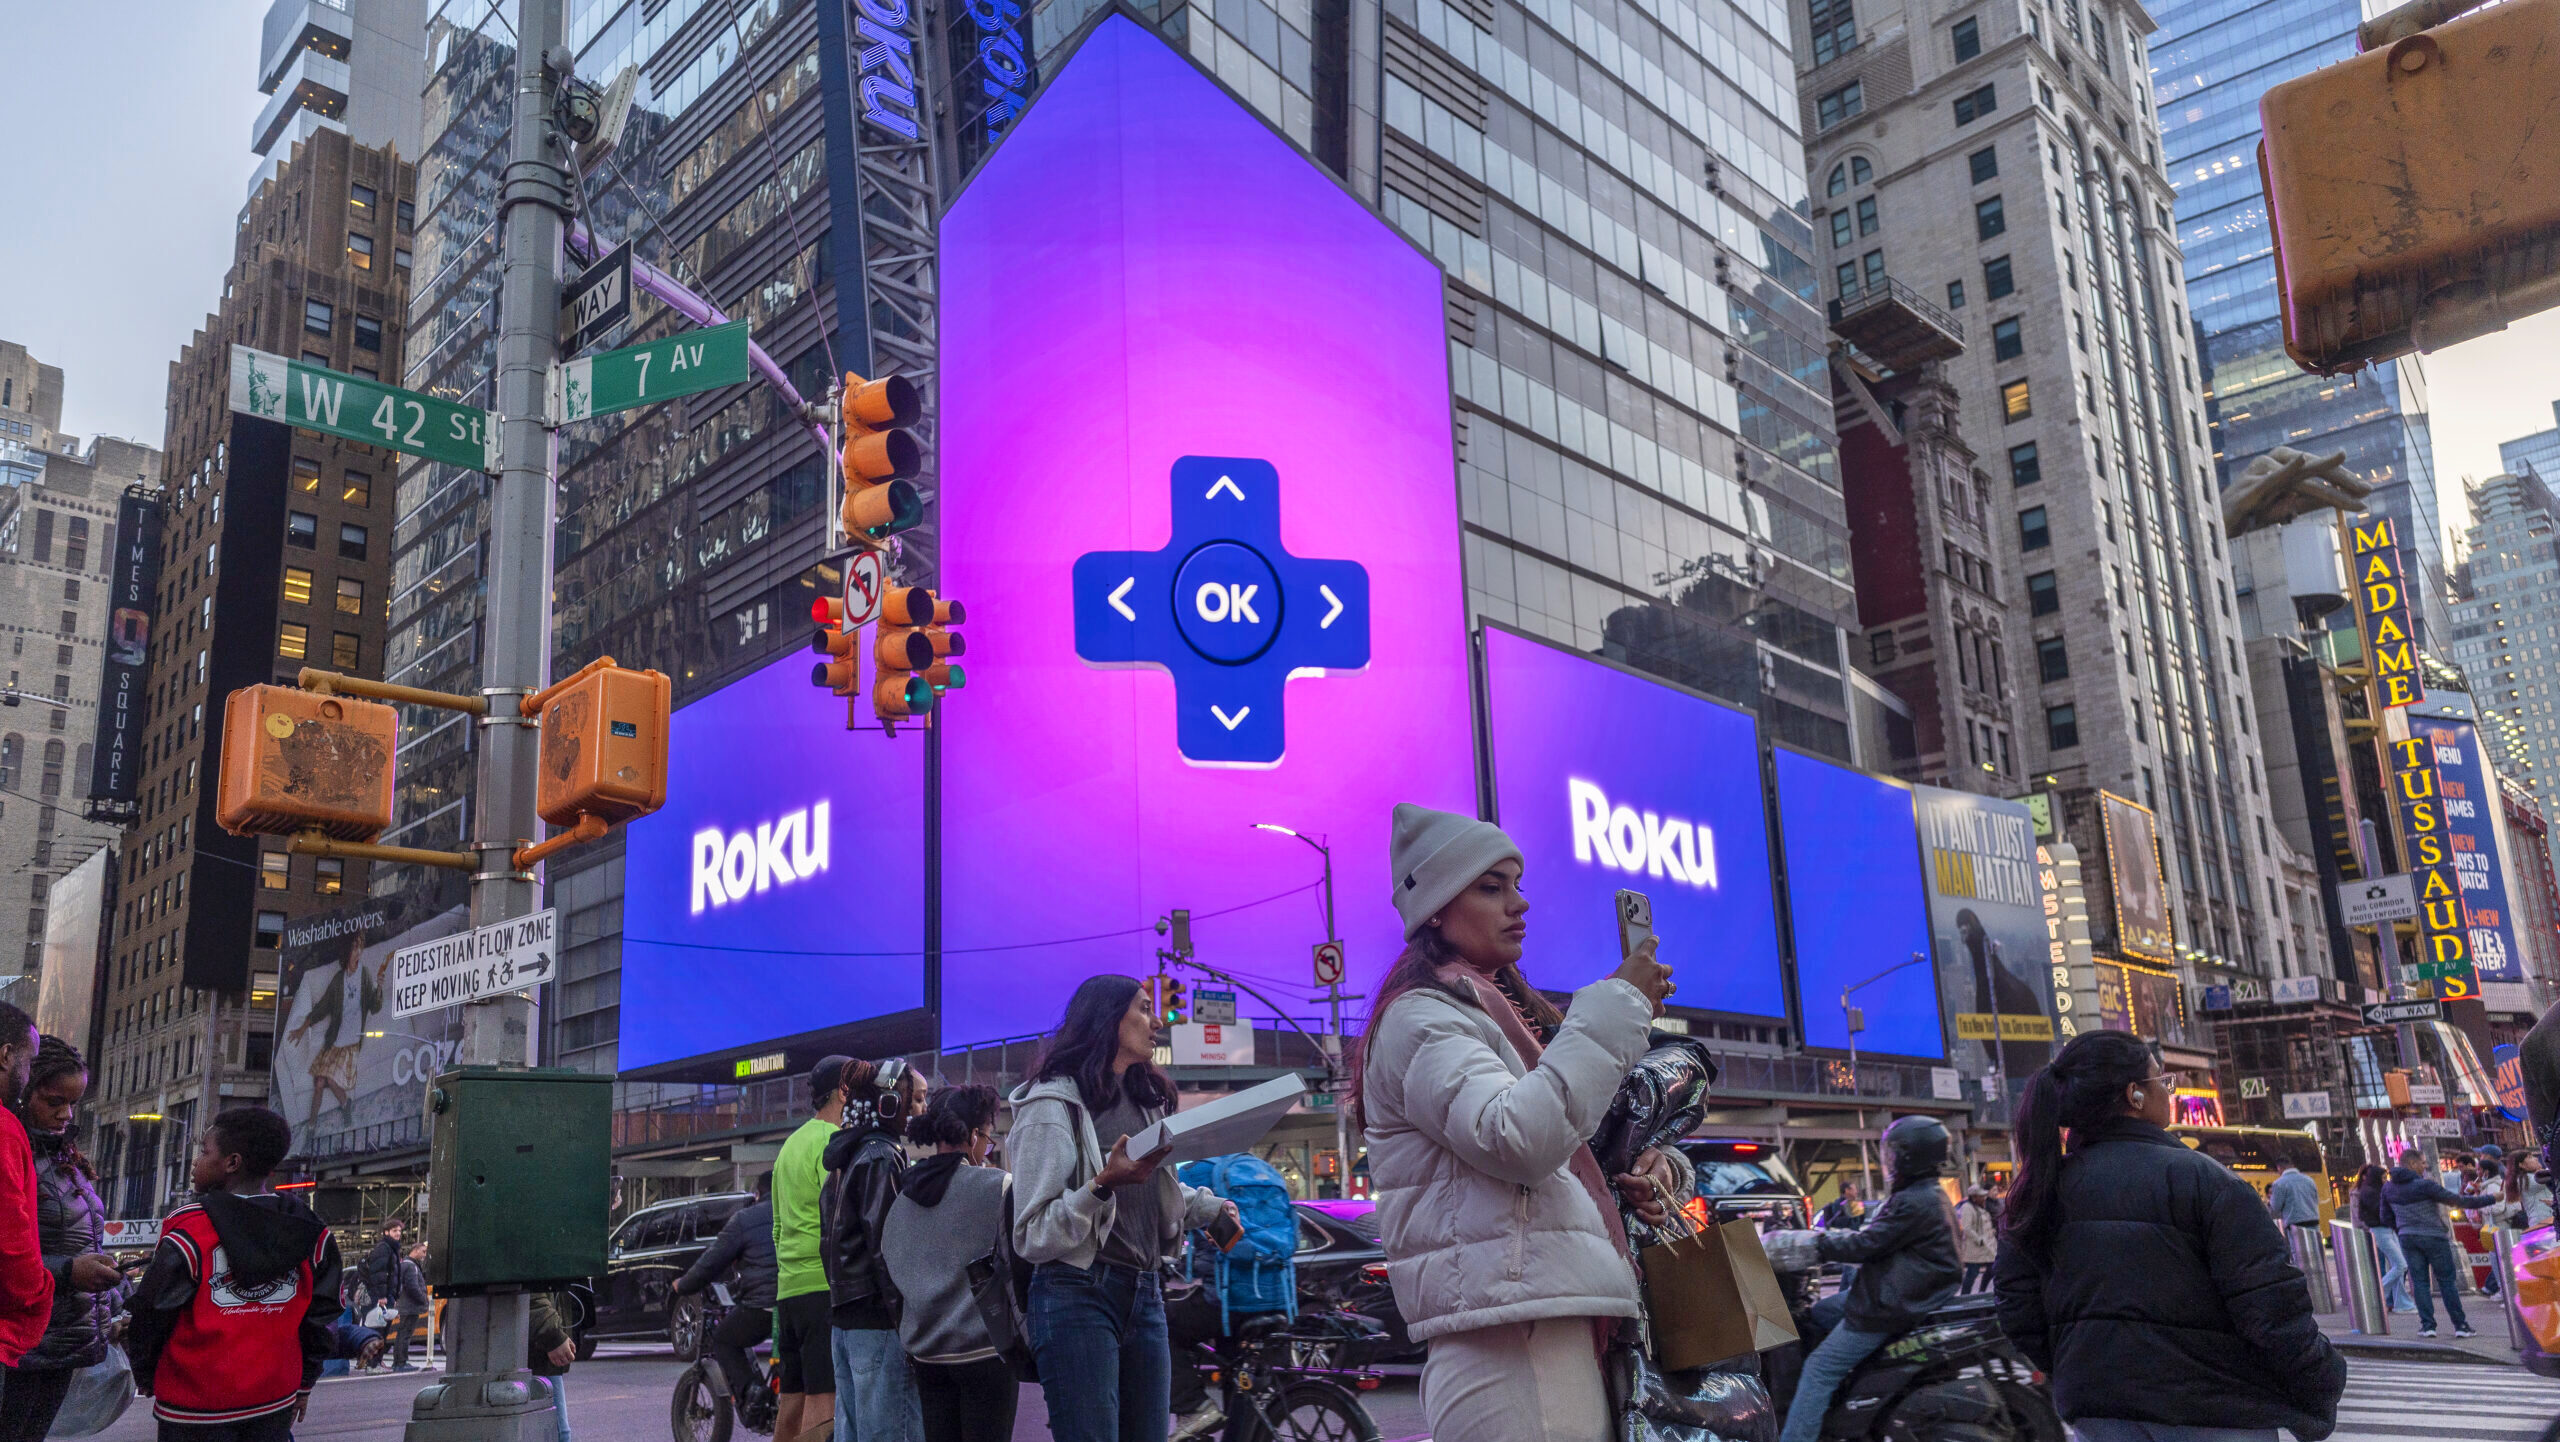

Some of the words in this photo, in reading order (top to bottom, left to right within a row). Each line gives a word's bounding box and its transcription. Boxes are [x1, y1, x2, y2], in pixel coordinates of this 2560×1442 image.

[573, 274, 616, 330] WAY
[634, 352, 652, 398] 7
[670, 342, 705, 373] Av
[302, 373, 345, 427] W
[371, 395, 426, 449] 42
[449, 413, 482, 446] St
[129, 507, 147, 602] TIMES
[1195, 582, 1260, 623] OK
[2355, 520, 2414, 706] MADAME
[109, 672, 131, 790] SQUARE
[2432, 728, 2456, 746] NEW
[2434, 746, 2463, 765] MENU
[2442, 780, 2466, 798] NEW
[1927, 801, 1946, 848] IT
[1991, 812, 2029, 862] JUST
[2452, 833, 2476, 851] NEW
[1932, 847, 2036, 907] MANHATTAN
[2396, 737, 2468, 998] TUSSAUDS
[2455, 852, 2475, 870] AYS
[2474, 853, 2489, 871] TO
[2350, 913, 2373, 922] PHOTO
[2374, 907, 2412, 918] ENFORCED
[2353, 904, 2367, 912] BUS
[2369, 898, 2405, 909] CORRIDOR
[288, 918, 342, 948] Washable
[343, 909, 385, 937] covers.
[396, 936, 475, 980] PEDESTRIAN
[478, 925, 514, 960] FLOW
[517, 915, 553, 947] ZONE
[2036, 845, 2078, 1046] AMSTERDA
[396, 982, 427, 1012] KEEP
[431, 969, 480, 1004] MOVING
[2432, 964, 2439, 977] 7
[2373, 1008, 2395, 1019] ONE
[2406, 1003, 2431, 1016] WAY
[1201, 1053, 1226, 1061] MINISO
[125, 1221, 158, 1235] NY
[236, 1284, 274, 1298] CHAMPIONS
